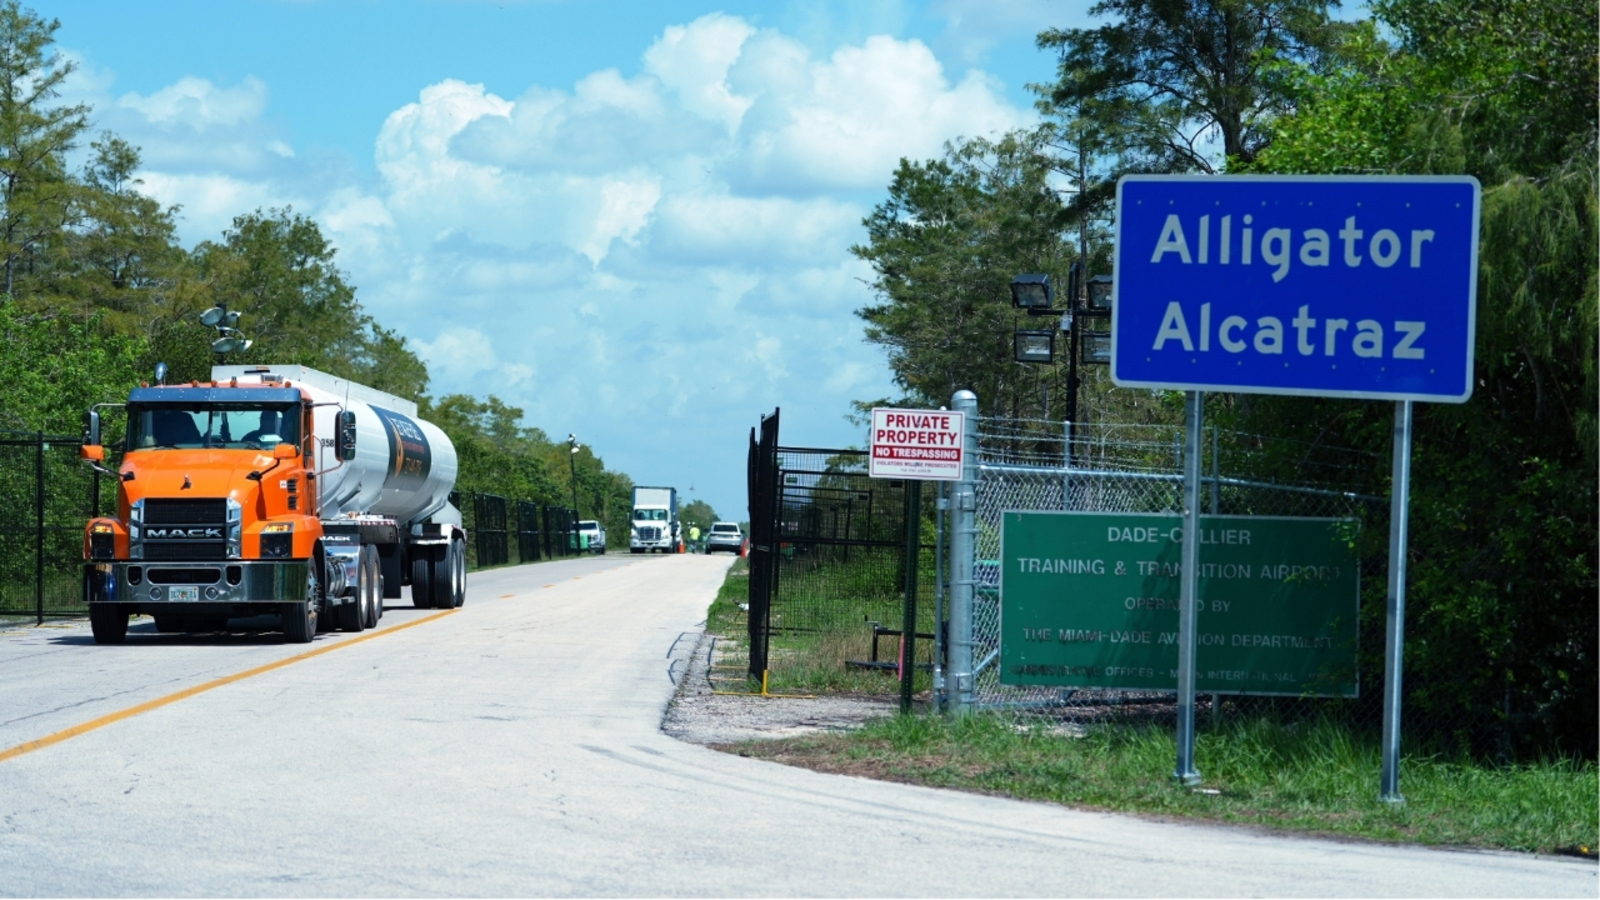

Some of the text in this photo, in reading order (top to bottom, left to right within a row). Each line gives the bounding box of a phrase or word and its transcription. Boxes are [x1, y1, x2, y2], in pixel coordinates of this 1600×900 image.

[1151, 214, 1435, 283] Alligator
[1152, 301, 1426, 359] Alcatraz
[886, 414, 950, 430] PRIVATE
[877, 429, 957, 446] PROPERTY
[875, 447, 958, 460] NO TRESPASSING
[925, 462, 957, 470] PROSECUTED
[147, 527, 222, 538] MACK
[1107, 526, 1251, 545] DADE-CLLIER
[1017, 558, 1105, 575] TRAINING
[1114, 560, 1127, 576] &
[1136, 561, 1251, 579] TRANITION
[1212, 601, 1231, 612] BY
[1023, 628, 1052, 642] THE
[1059, 629, 1151, 644] MIAMI-DADE
[1231, 634, 1334, 649] DEPARTMENT
[1105, 666, 1154, 678] OFFICES
